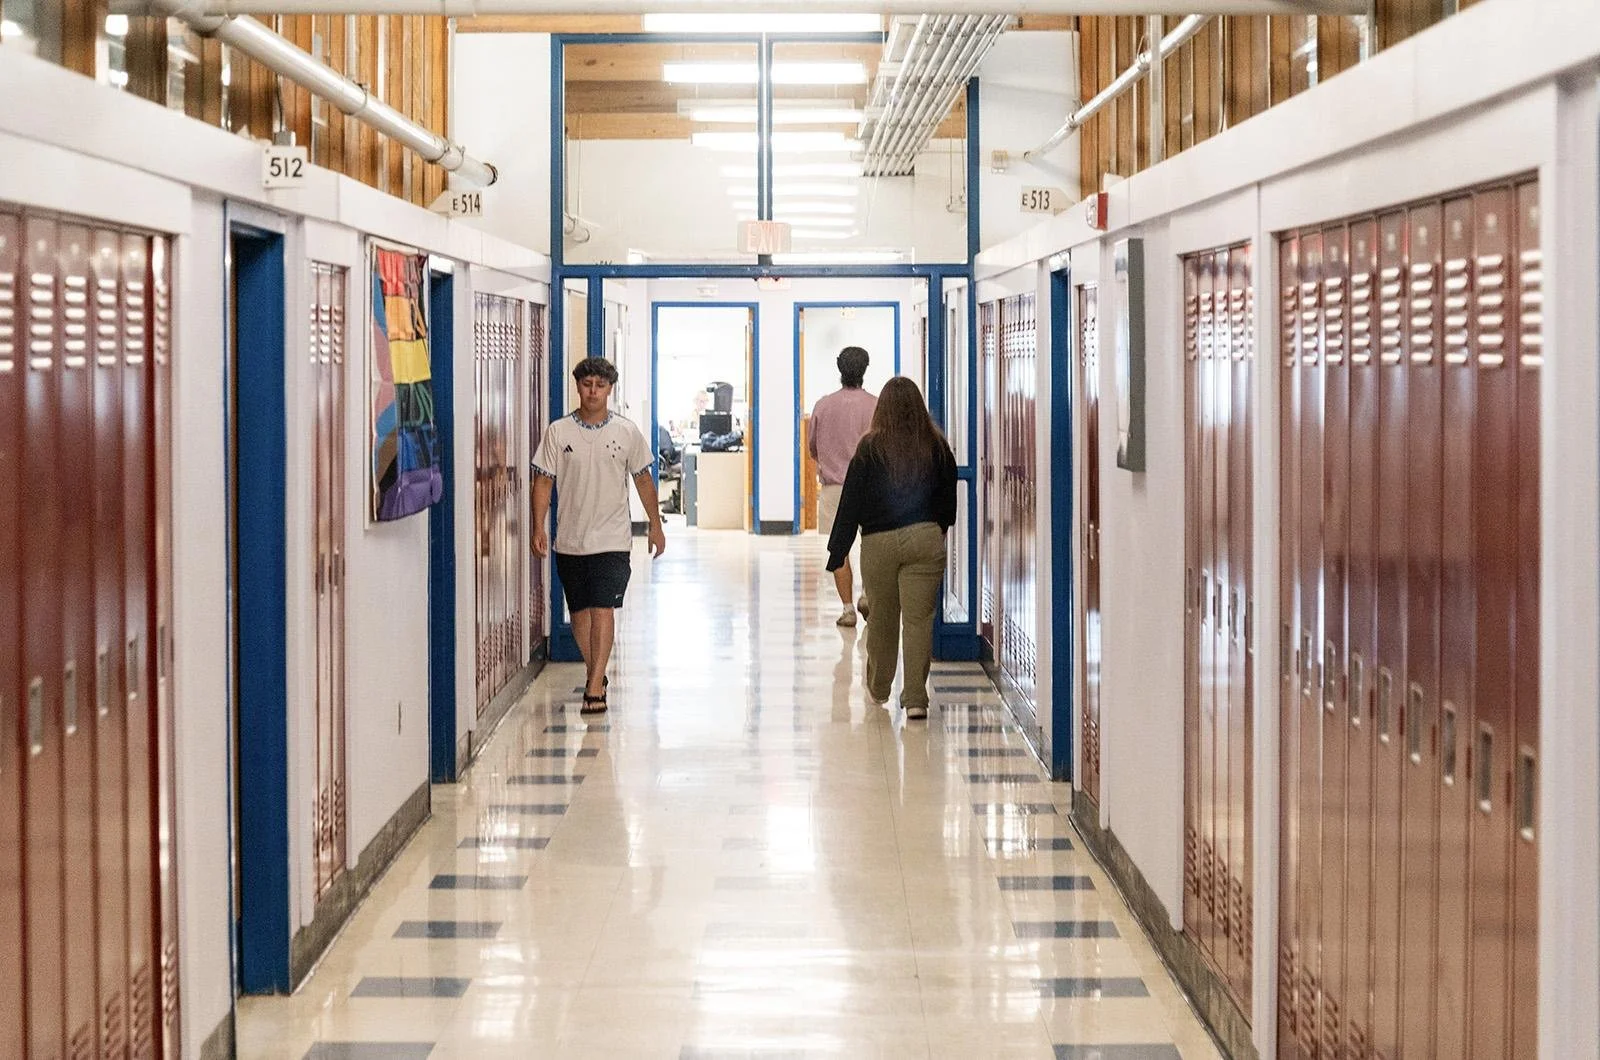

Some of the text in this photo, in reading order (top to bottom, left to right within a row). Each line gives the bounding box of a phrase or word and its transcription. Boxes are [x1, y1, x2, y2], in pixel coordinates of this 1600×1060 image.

[270, 157, 303, 178] 512
[452, 193, 481, 214] E 514
[1021, 190, 1050, 210] E 513
[747, 222, 785, 253] EXIT
